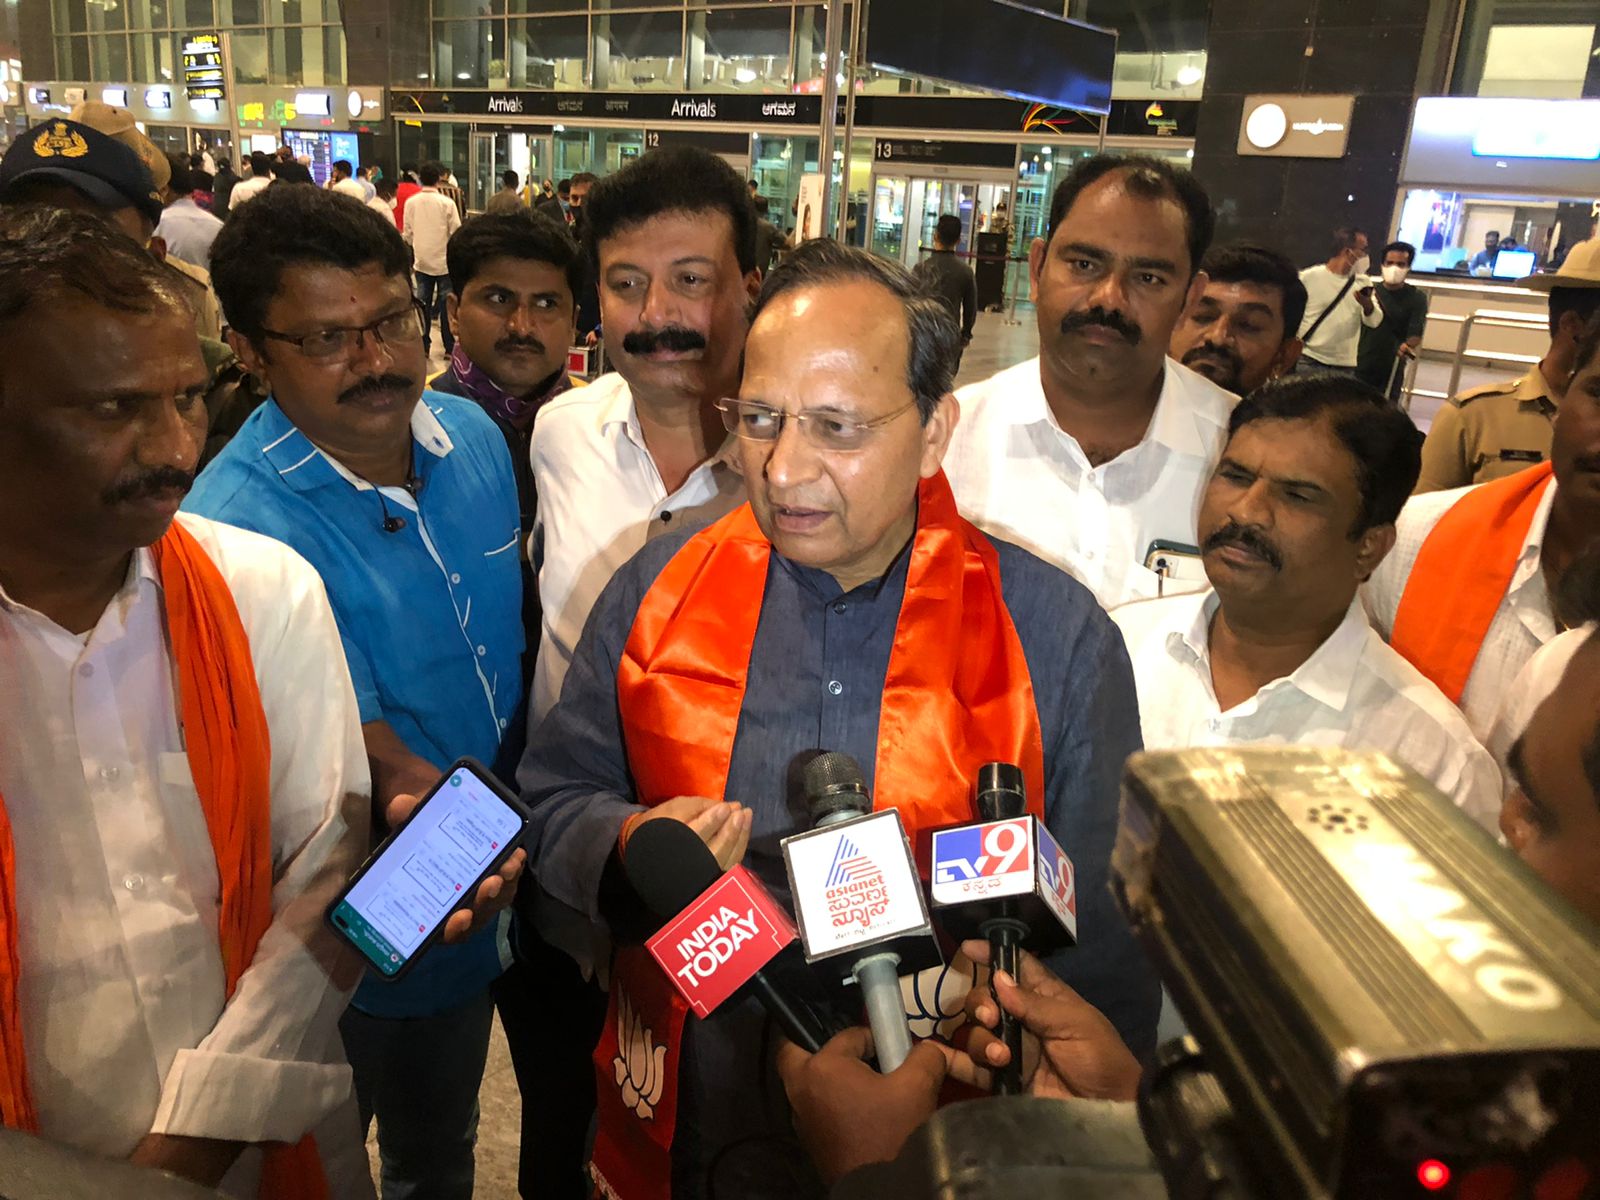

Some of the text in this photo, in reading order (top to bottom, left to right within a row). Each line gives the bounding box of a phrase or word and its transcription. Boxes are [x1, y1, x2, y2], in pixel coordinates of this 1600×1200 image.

[488, 95, 524, 113] Arrivals
[671, 98, 717, 118] Arrivals
[761, 101, 797, 117] ಆಗಮನ
[647, 133, 660, 147] 12
[876, 142, 893, 159] 13
[936, 823, 1027, 884] TV9
[825, 874, 885, 899] asianet
[827, 885, 889, 913] ಸುವರ್ಣ
[676, 905, 740, 962] INDIA
[676, 907, 760, 988] TODAY
